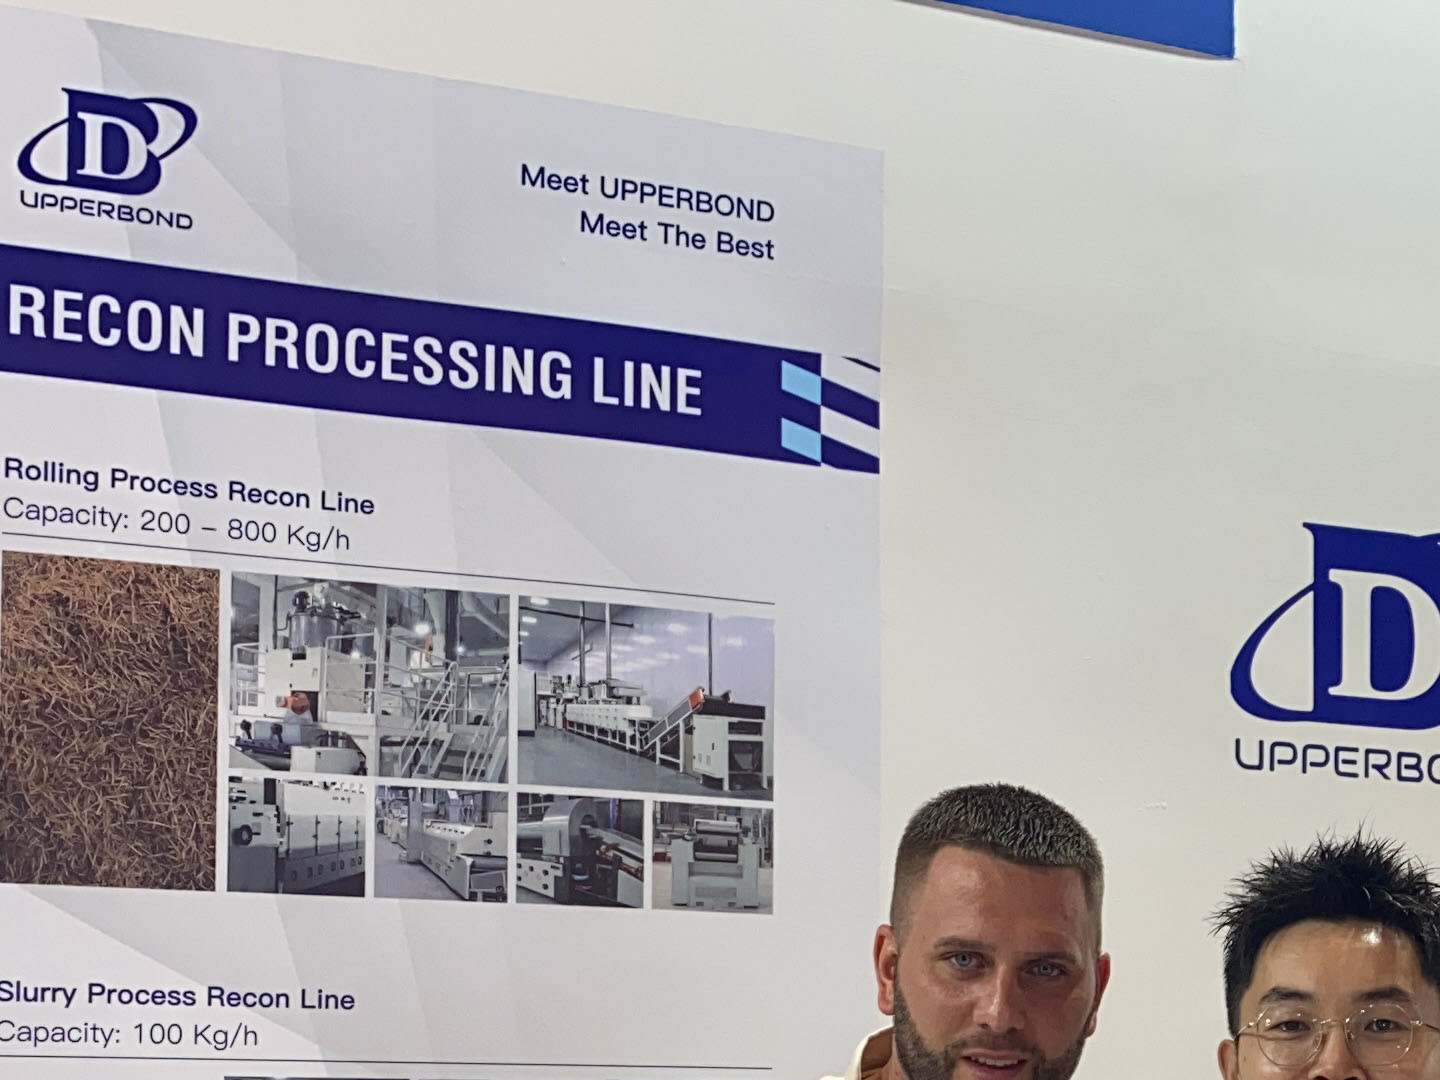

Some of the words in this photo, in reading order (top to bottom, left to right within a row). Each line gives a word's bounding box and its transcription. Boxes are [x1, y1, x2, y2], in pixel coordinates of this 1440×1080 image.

[19, 189, 194, 230] UPPERBOND
[520, 162, 590, 195] Meet
[600, 175, 775, 222] UPPERBOND
[579, 209, 648, 241] Meet
[657, 221, 706, 250] The
[716, 230, 775, 260] Best
[7, 282, 204, 358] RECON
[226, 311, 573, 400] PROCESSING
[592, 356, 703, 416] LINE
[3, 456, 99, 492] Rolling
[110, 467, 218, 500] Process
[228, 480, 311, 509] Recon
[321, 490, 376, 515] Line
[3, 496, 129, 534] Capacity:
[140, 509, 191, 535] 200
[227, 518, 278, 544] 800
[286, 523, 350, 553] Kg/h
[0, 980, 77, 1009] Slurry
[86, 983, 197, 1007] Process
[206, 986, 290, 1010] Recon
[300, 988, 356, 1011] Line
[0, 1019, 121, 1048] Capacity:
[133, 1022, 183, 1046] 100
[193, 1021, 258, 1051] Kg/h
